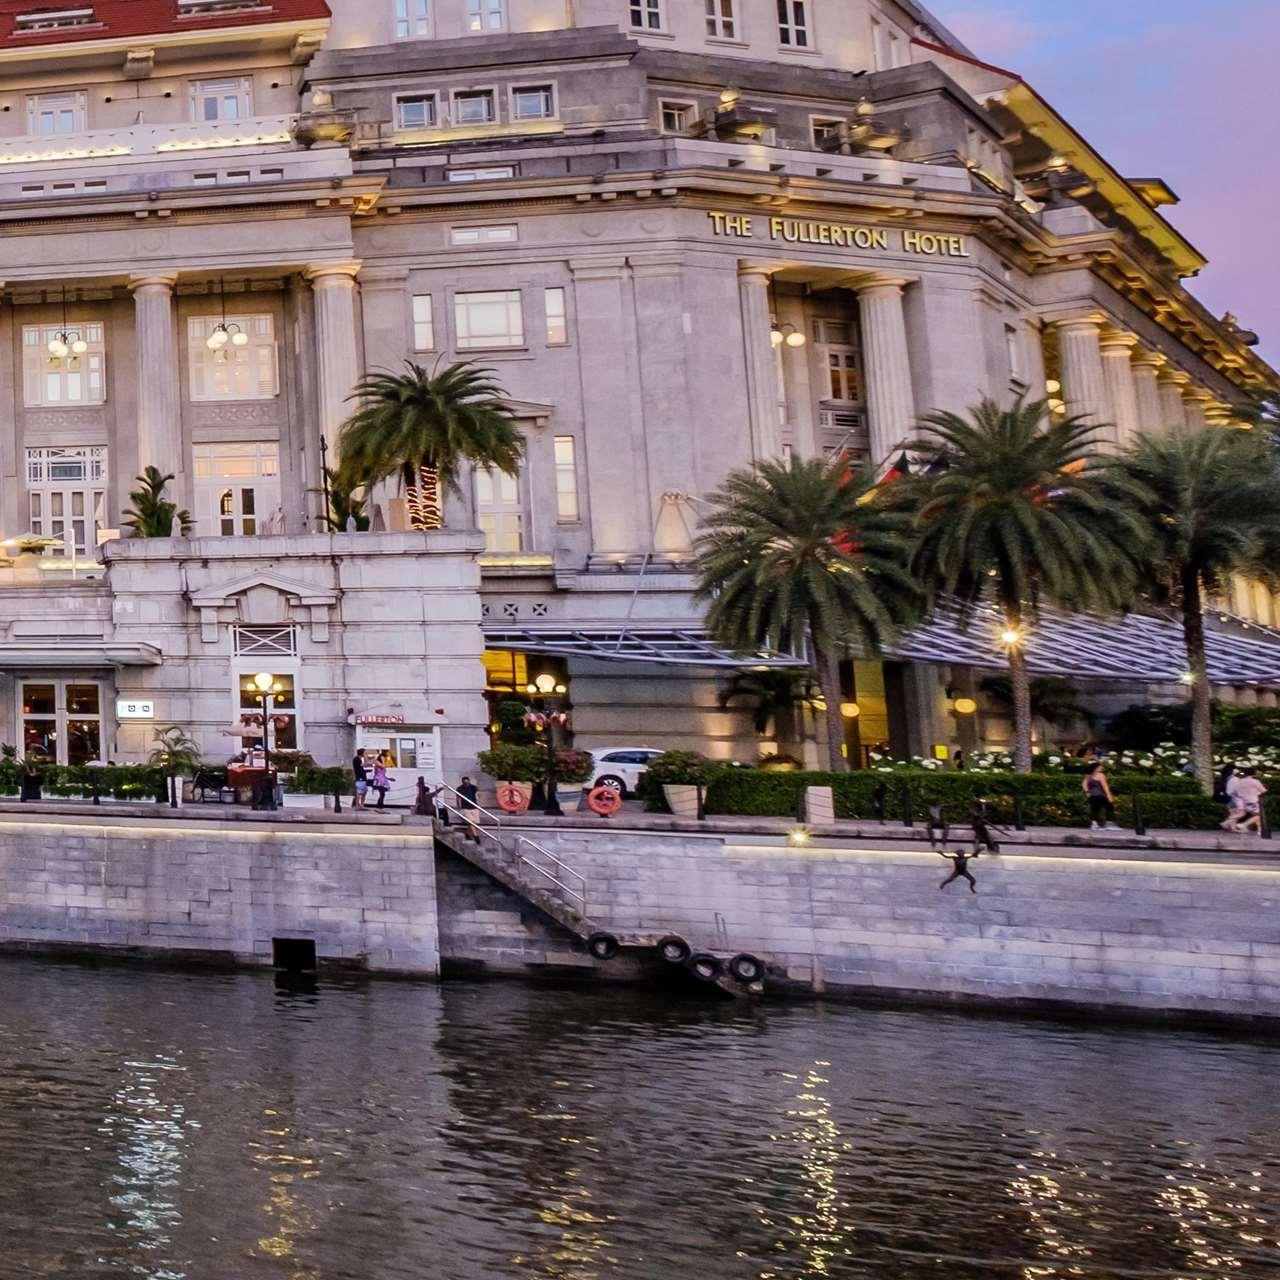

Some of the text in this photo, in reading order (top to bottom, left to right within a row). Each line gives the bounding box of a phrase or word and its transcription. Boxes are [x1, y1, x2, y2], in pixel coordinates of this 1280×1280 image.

[708, 212, 971, 257] THE FULLERTON HOTEL
